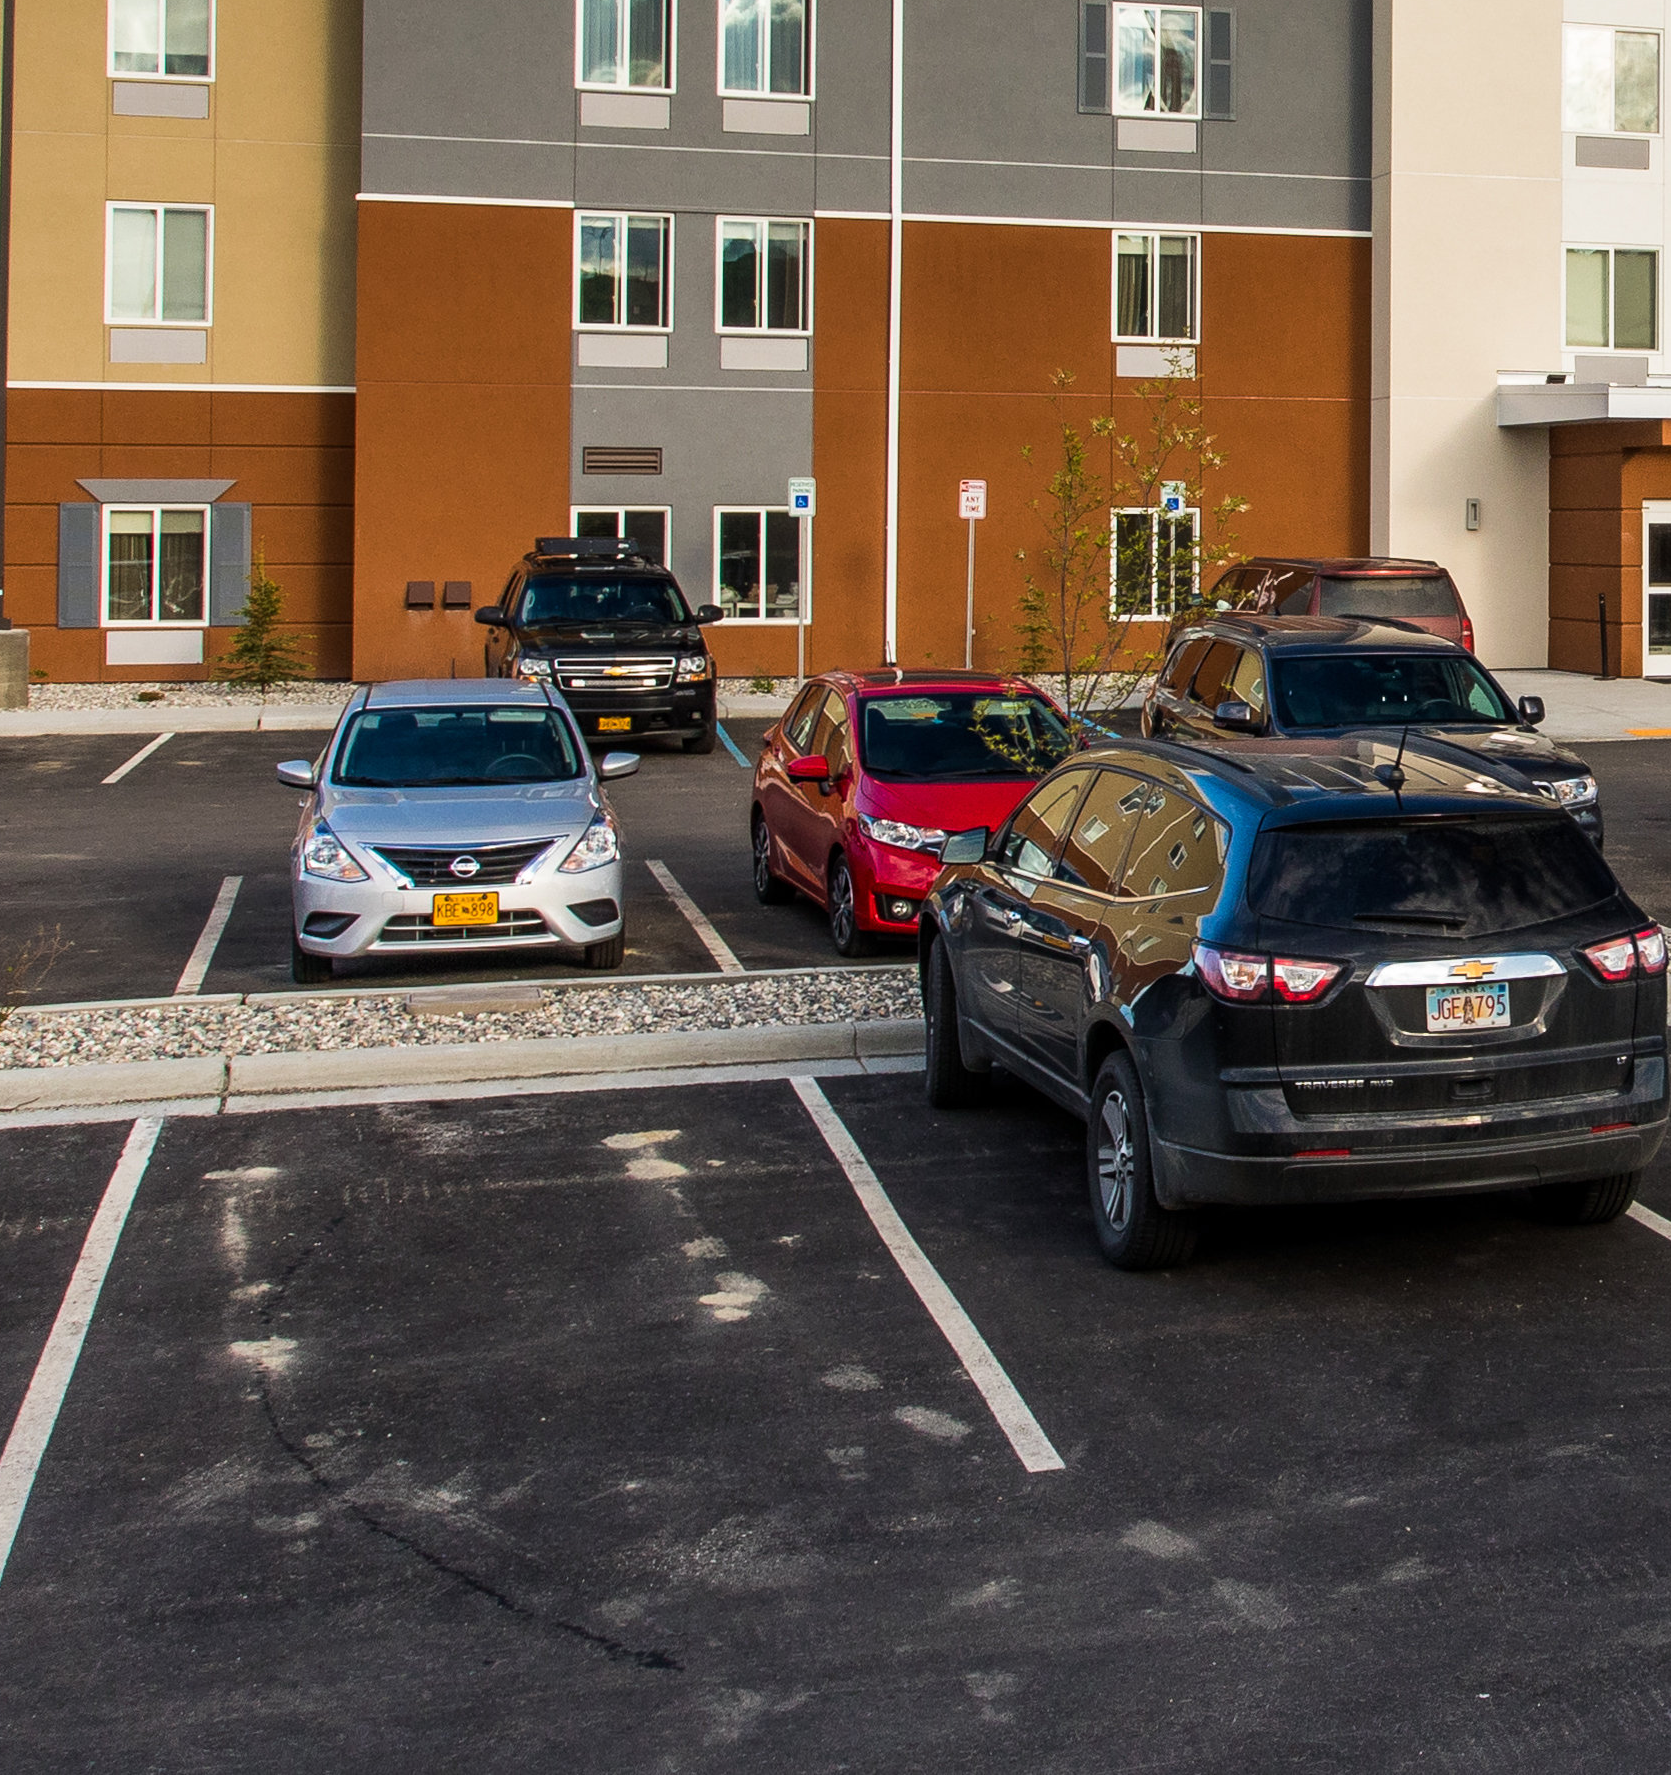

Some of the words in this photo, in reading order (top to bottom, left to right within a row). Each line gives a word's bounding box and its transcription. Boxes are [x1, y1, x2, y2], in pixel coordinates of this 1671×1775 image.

[437, 904, 460, 918] KBE
[471, 902, 495, 916] 898
[1450, 986, 1486, 995] ALASKA
[1431, 997, 1462, 1020] JGE
[1475, 994, 1506, 1018] 795
[1295, 1079, 1365, 1090] TRAVERSE
